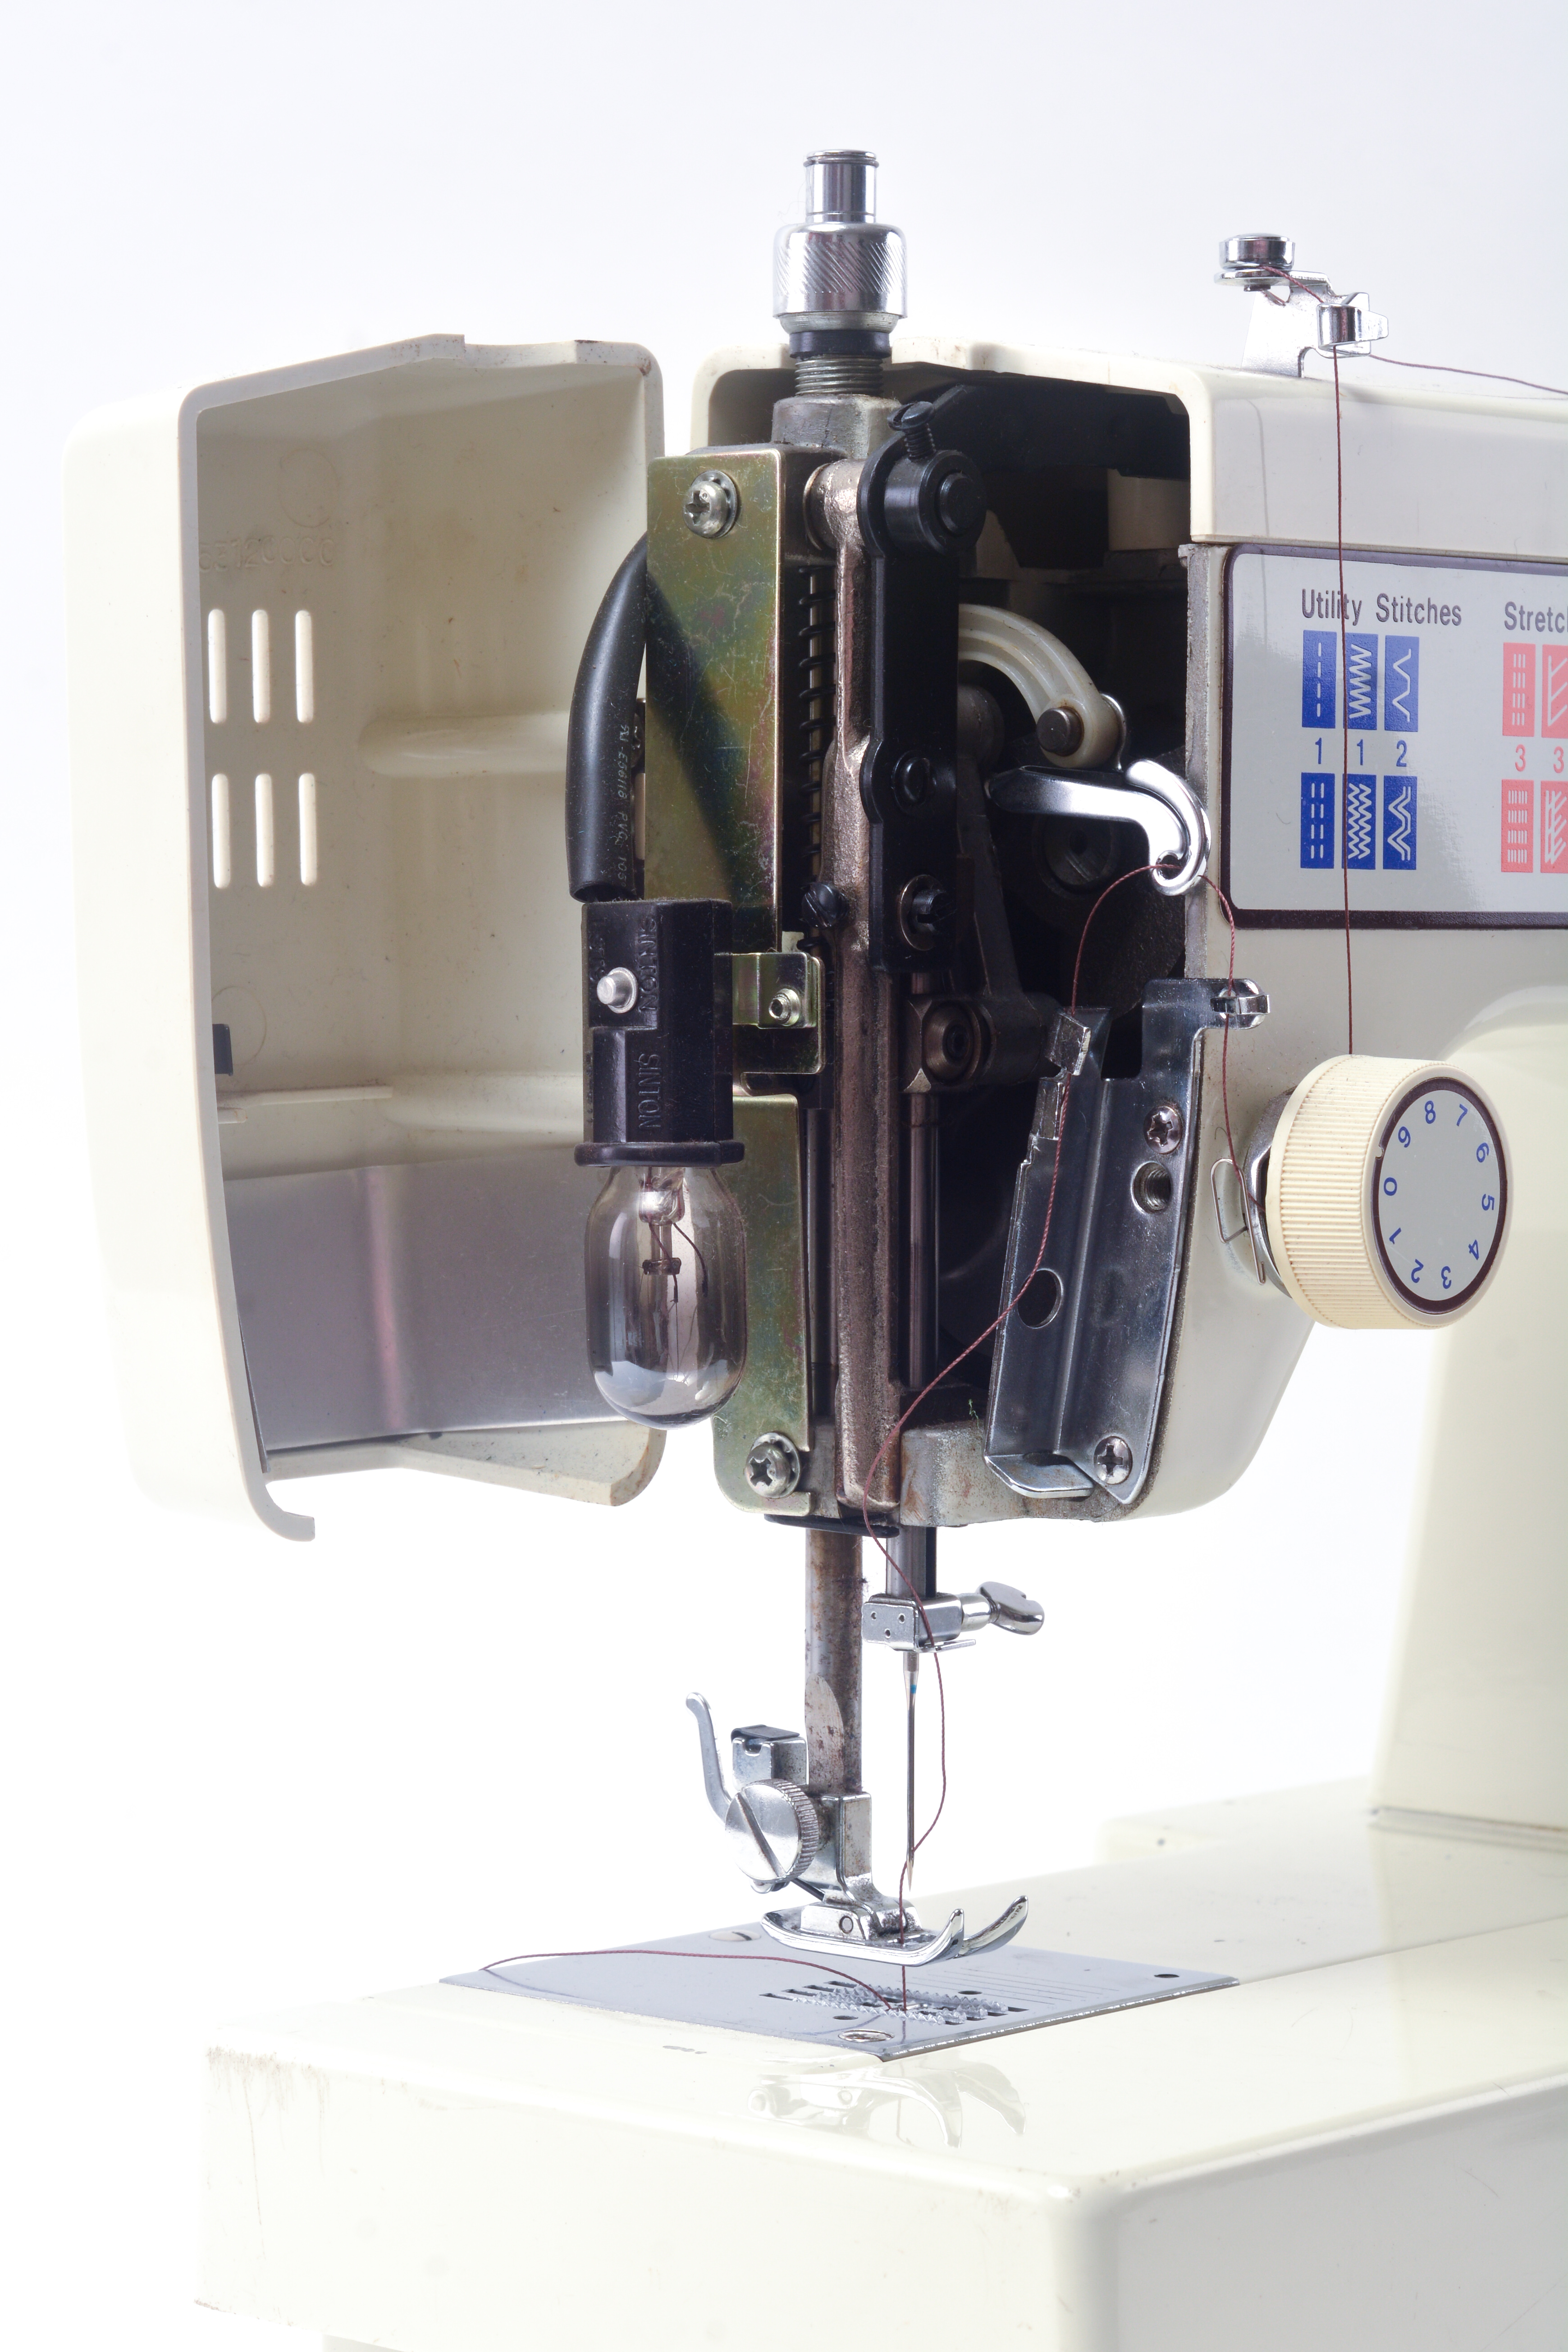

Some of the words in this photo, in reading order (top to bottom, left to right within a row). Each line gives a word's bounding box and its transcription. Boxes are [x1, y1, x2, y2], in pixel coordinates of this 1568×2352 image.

[1302, 588, 1362, 626] Utility
[1376, 593, 1462, 626] Stitches
[1504, 601, 1568, 634] Stretc
[1315, 737, 1323, 764] 1
[1356, 739, 1364, 766] 1
[1395, 740, 1408, 767] 2
[1514, 744, 1527, 772] 3
[1553, 746, 1564, 773] 3
[638, 1053, 661, 1130] SINTON
[1424, 1100, 1436, 1124] 8
[1456, 1104, 1468, 1126] 7
[1398, 1126, 1412, 1148] 9
[1476, 1142, 1490, 1163] 6
[1383, 1177, 1398, 1196] 0
[1481, 1193, 1495, 1211] 5
[1388, 1227, 1402, 1244] 1
[1468, 1239, 1480, 1260] 4
[1411, 1259, 1424, 1283] 2
[1440, 1265, 1452, 1289] 3
